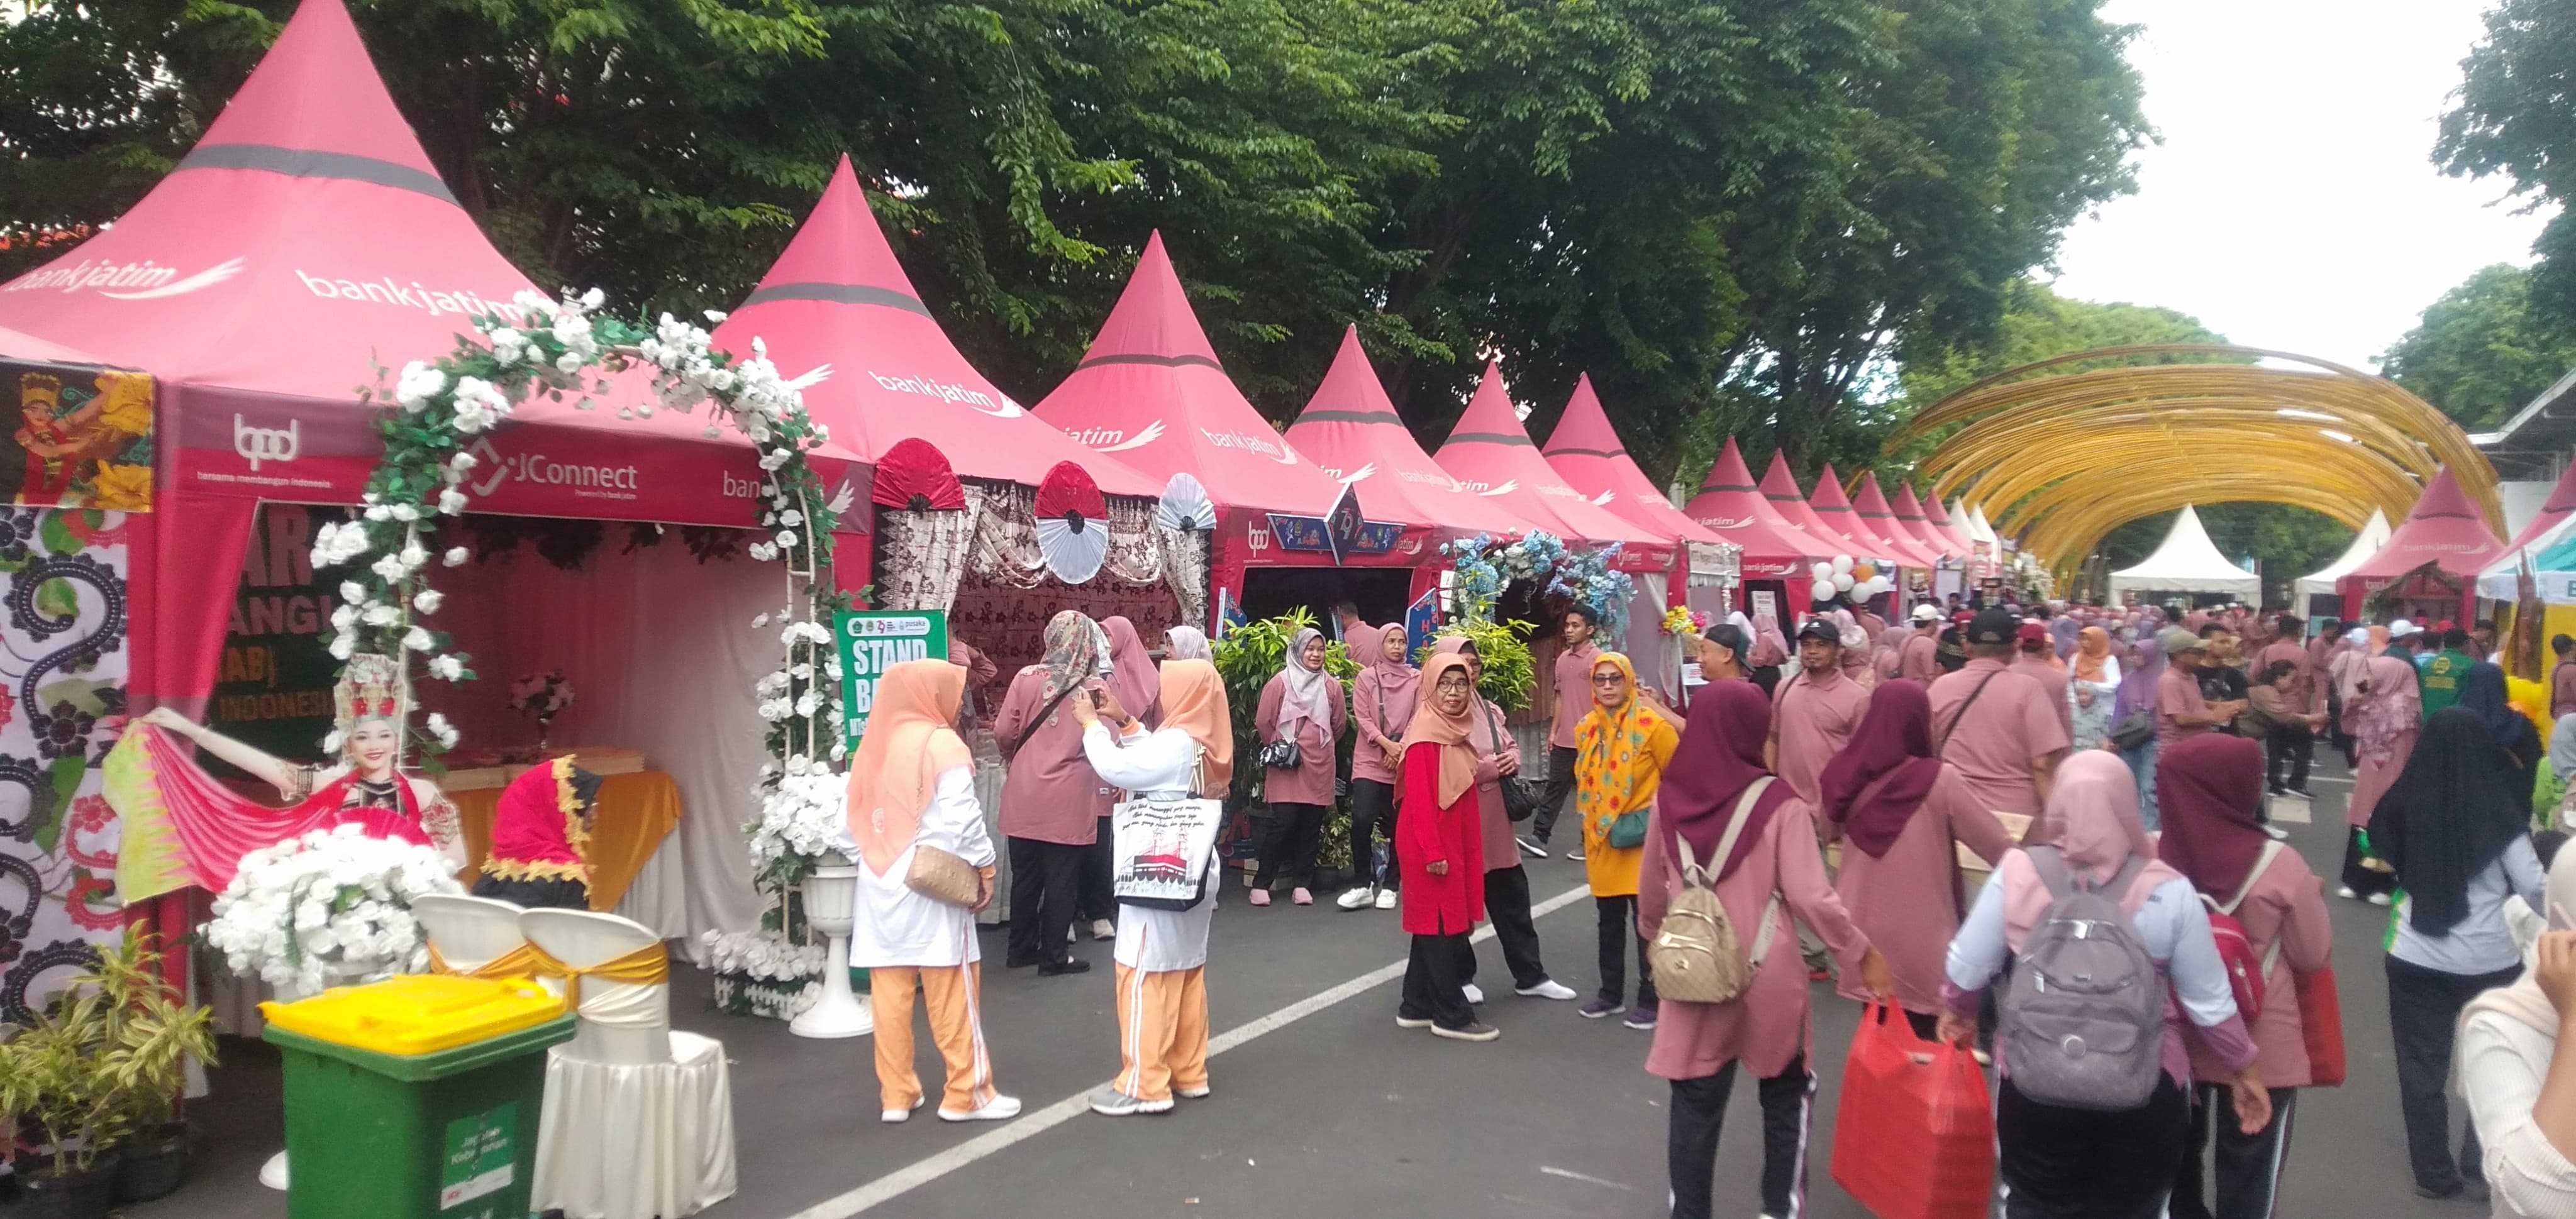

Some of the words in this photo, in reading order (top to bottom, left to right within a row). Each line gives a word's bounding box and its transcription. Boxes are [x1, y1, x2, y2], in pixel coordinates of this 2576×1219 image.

[867, 370, 997, 404] bankjatim
[1199, 426, 1282, 457] bankjatim
[514, 452, 638, 490] JConnect
